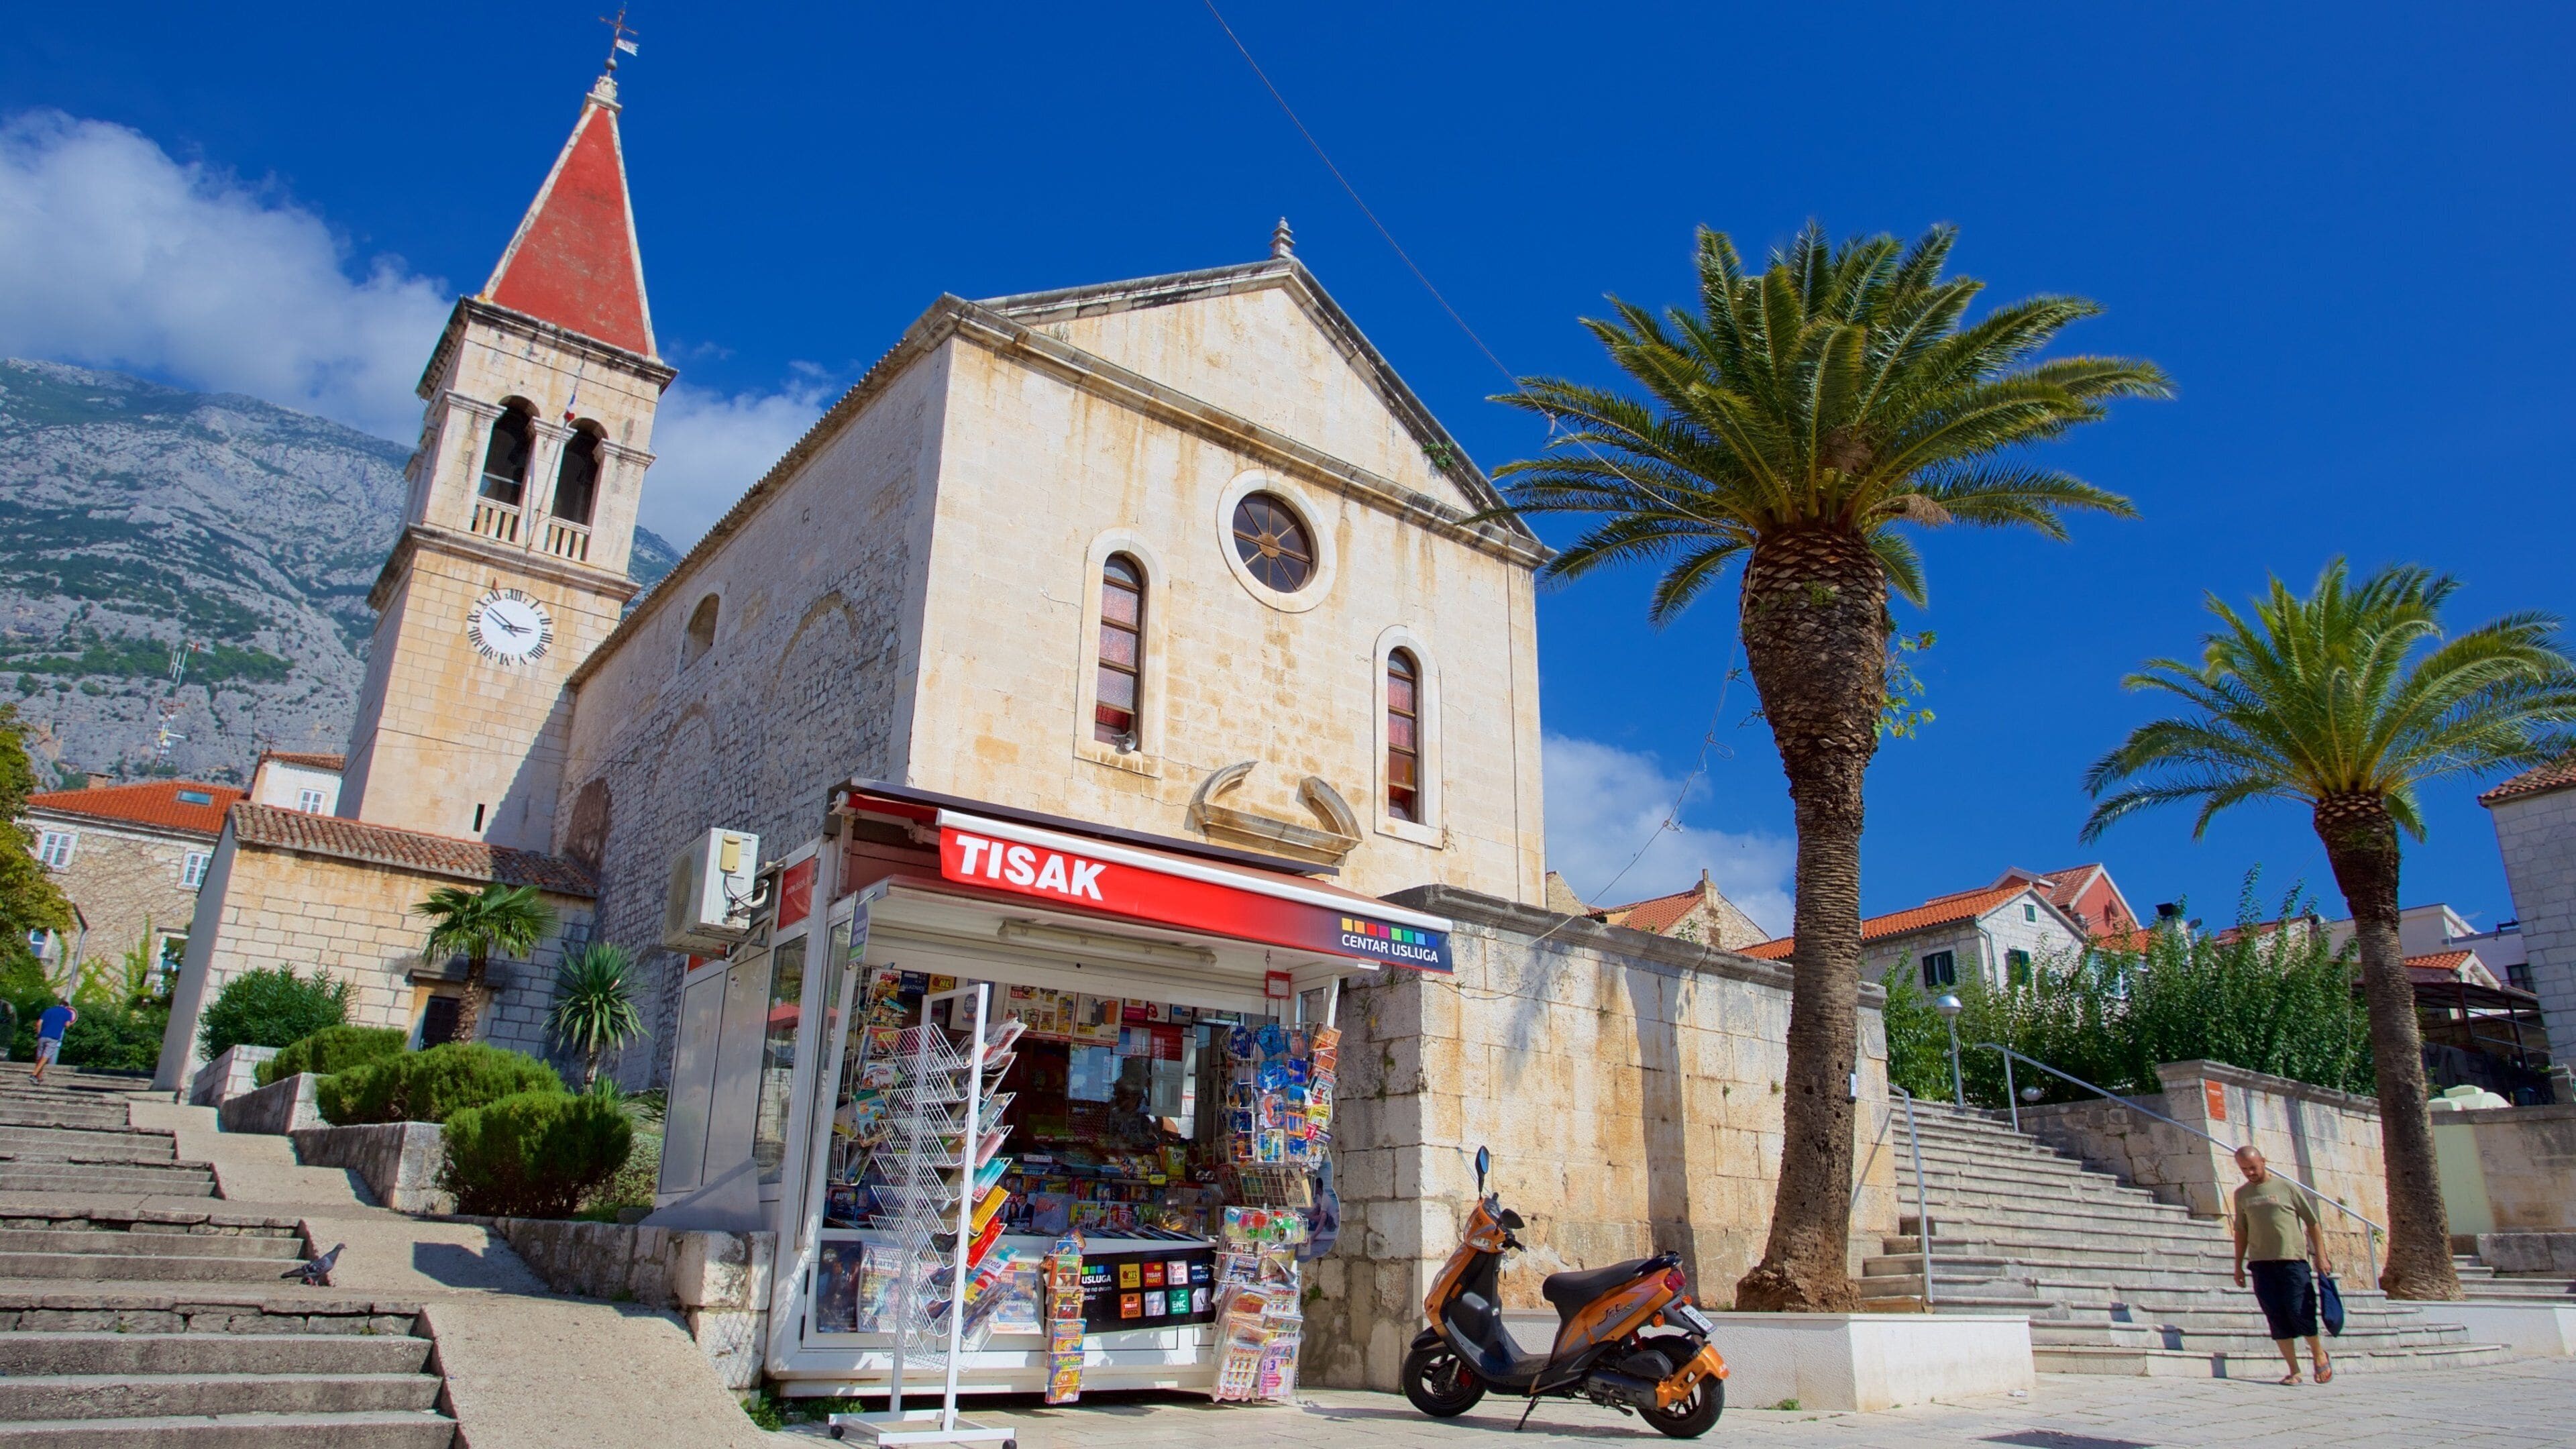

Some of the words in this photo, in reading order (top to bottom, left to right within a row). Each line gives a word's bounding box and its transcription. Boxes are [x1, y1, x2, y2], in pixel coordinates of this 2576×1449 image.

[956, 835, 1106, 901] TISAK
[1342, 934, 1389, 954] CENTAR
[1391, 944, 1439, 963] USLUGA
[1081, 1275, 1112, 1284] USLUGA
[1172, 1300, 1187, 1309] ENC
